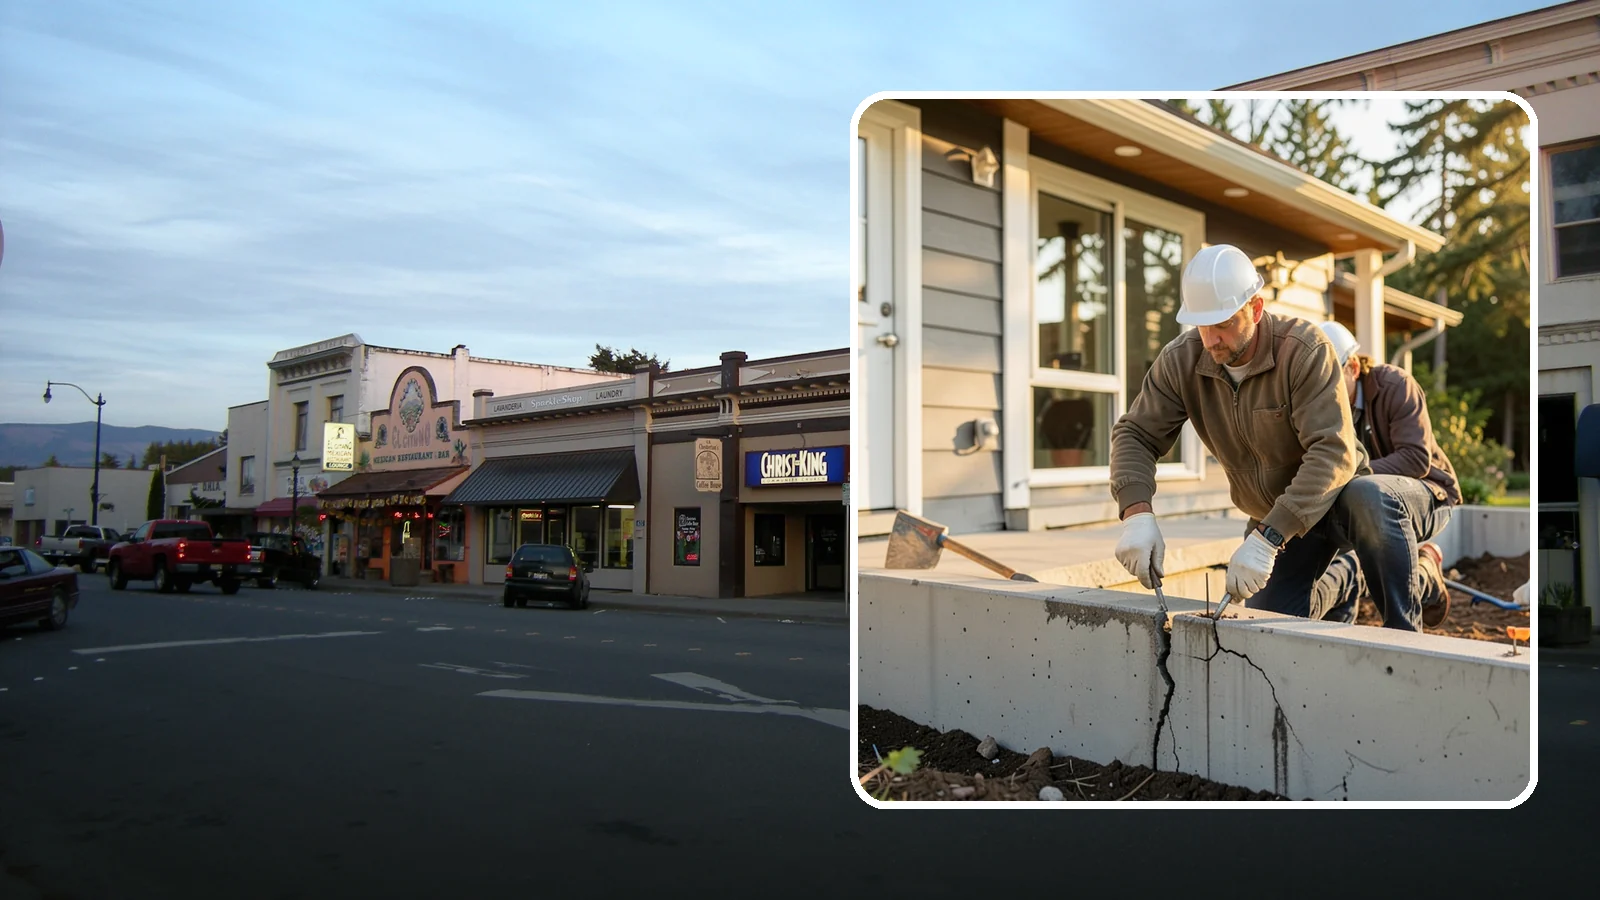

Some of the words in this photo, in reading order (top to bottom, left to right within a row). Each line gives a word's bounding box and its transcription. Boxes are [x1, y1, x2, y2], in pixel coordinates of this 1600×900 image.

[531, 396, 561, 408] Sparkle
[562, 394, 582, 405] Shop
[596, 389, 623, 400] LAUNDRY
[494, 402, 522, 412] LAVANDERIA
[373, 455, 396, 464] MEXICAN
[397, 451, 433, 462] RESTAURANT
[438, 450, 450, 459] BAR
[761, 452, 796, 478] CHRIST
[799, 450, 827, 476] KING
